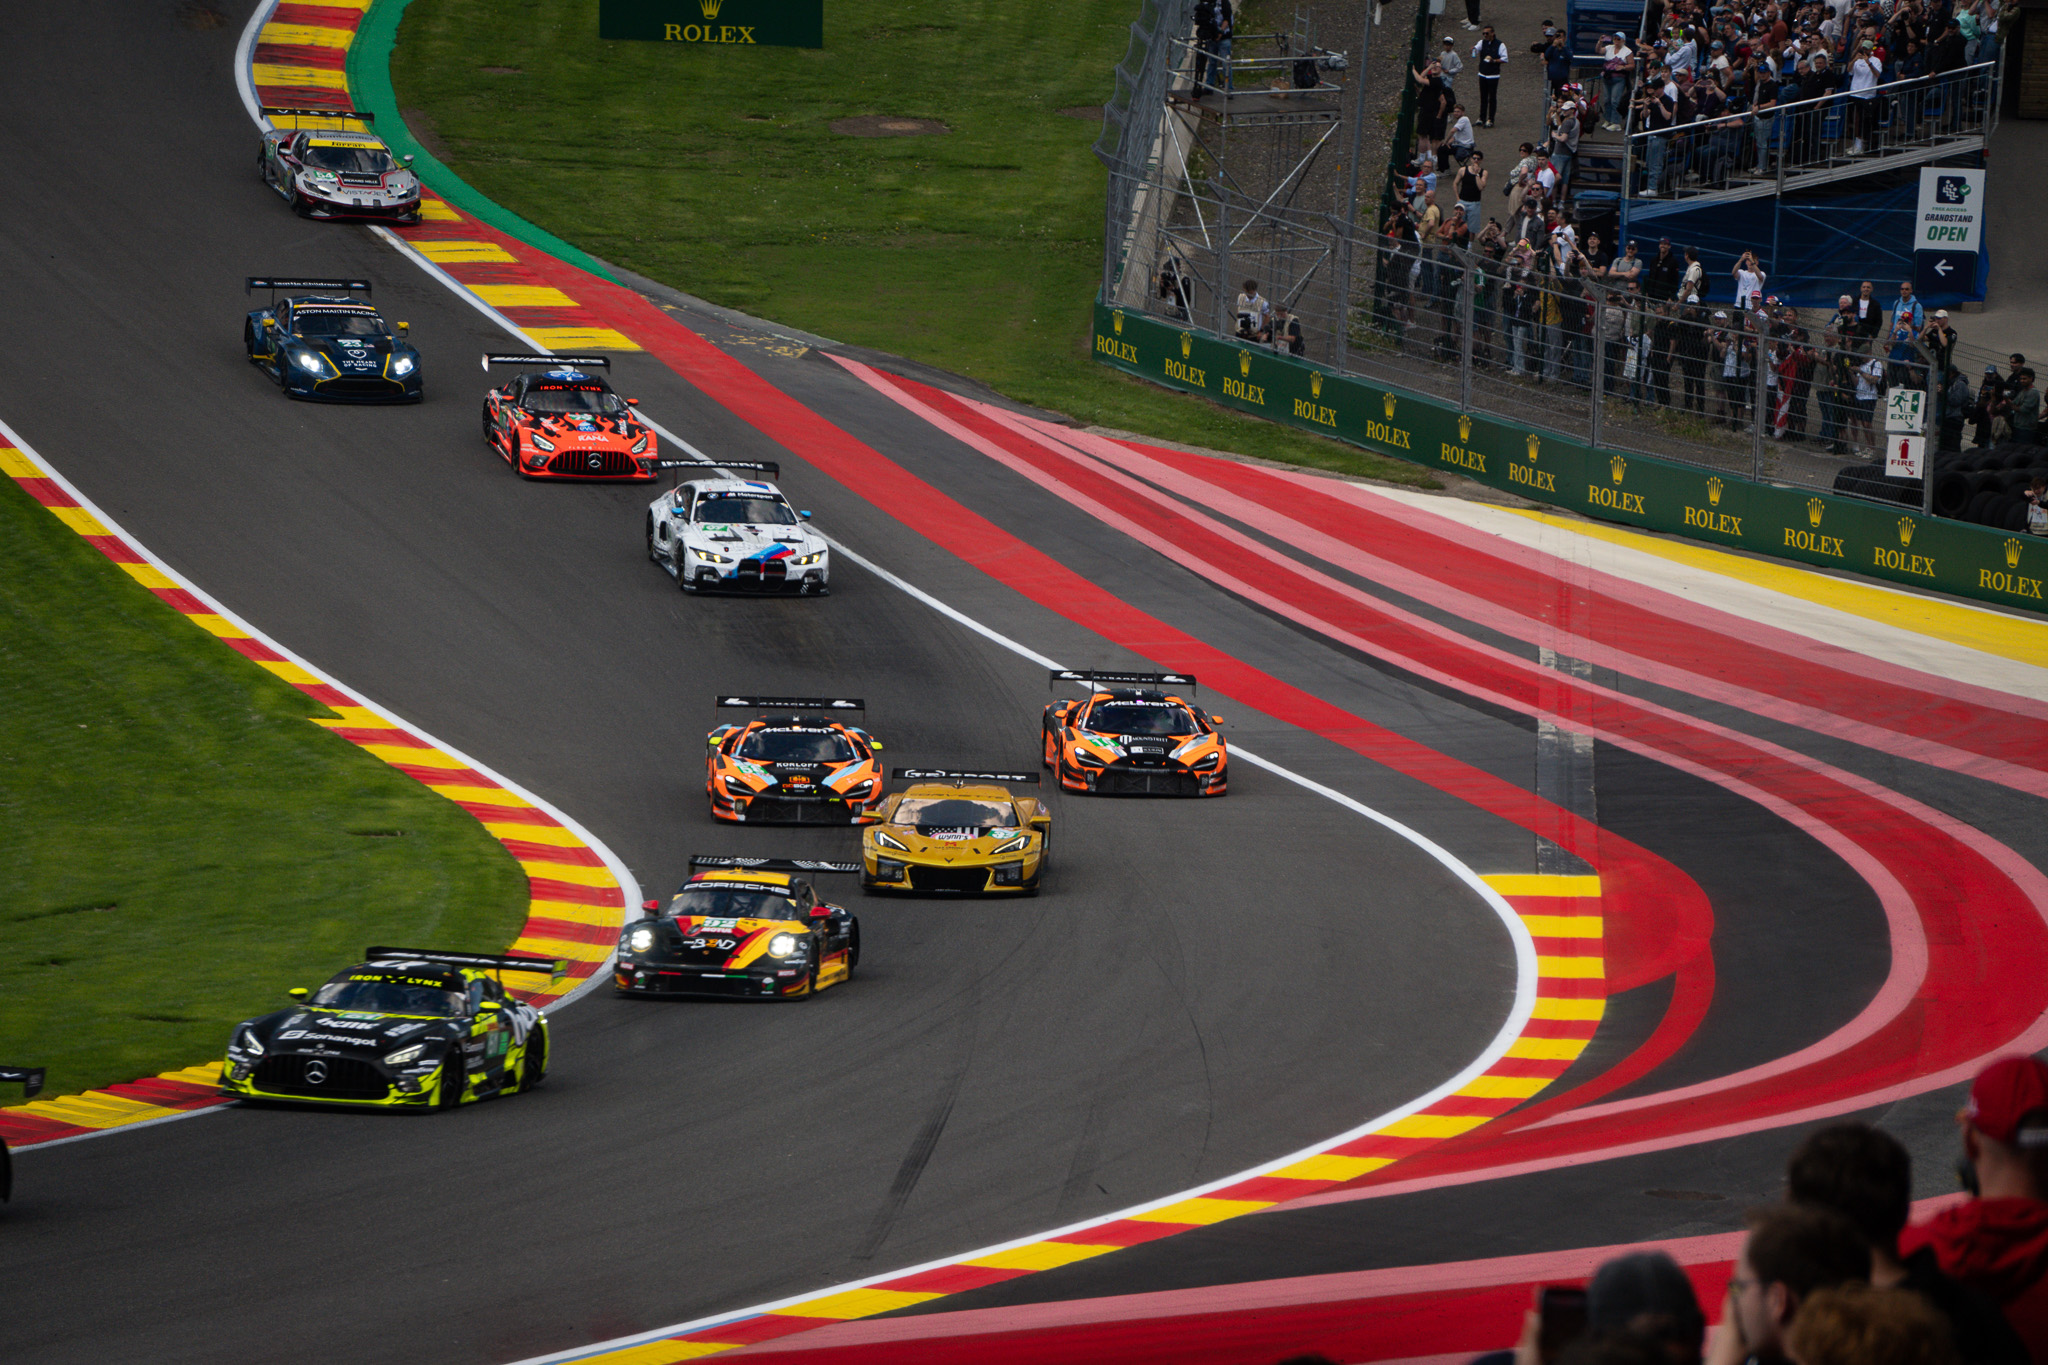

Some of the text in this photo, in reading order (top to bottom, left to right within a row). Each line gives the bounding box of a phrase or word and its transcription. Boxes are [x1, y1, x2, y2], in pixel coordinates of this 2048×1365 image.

[663, 23, 756, 44] ROLEX
[1924, 213, 1974, 223] GRANDSTAND
[1926, 225, 1969, 242] OPEN
[351, 309, 378, 317] RACING
[1096, 334, 1138, 364] ROLEX
[1164, 358, 1206, 388] ROLEX
[1223, 376, 1265, 405] ROLEX
[1294, 398, 1337, 427] ROLEX
[1890, 413, 1916, 421] EXIT
[578, 434, 609, 442] RANA
[1366, 419, 1411, 449] ROLEX
[1440, 442, 1487, 473] ROLEX
[1890, 458, 1915, 467] FIRE
[1508, 462, 1556, 492] ROLEX
[738, 492, 773, 500] Motorsport
[1588, 484, 1645, 514] ROLEX
[1684, 506, 1742, 536] ROLEX
[1784, 527, 1845, 558] ROLEX
[1874, 546, 1936, 577] ROLEX
[1979, 568, 2043, 600] ROLEX
[683, 882, 791, 896] PORSCHE
[703, 919, 735, 928] 92
[349, 974, 443, 987] IRON LYNX
[302, 1032, 377, 1047] Sonangol
